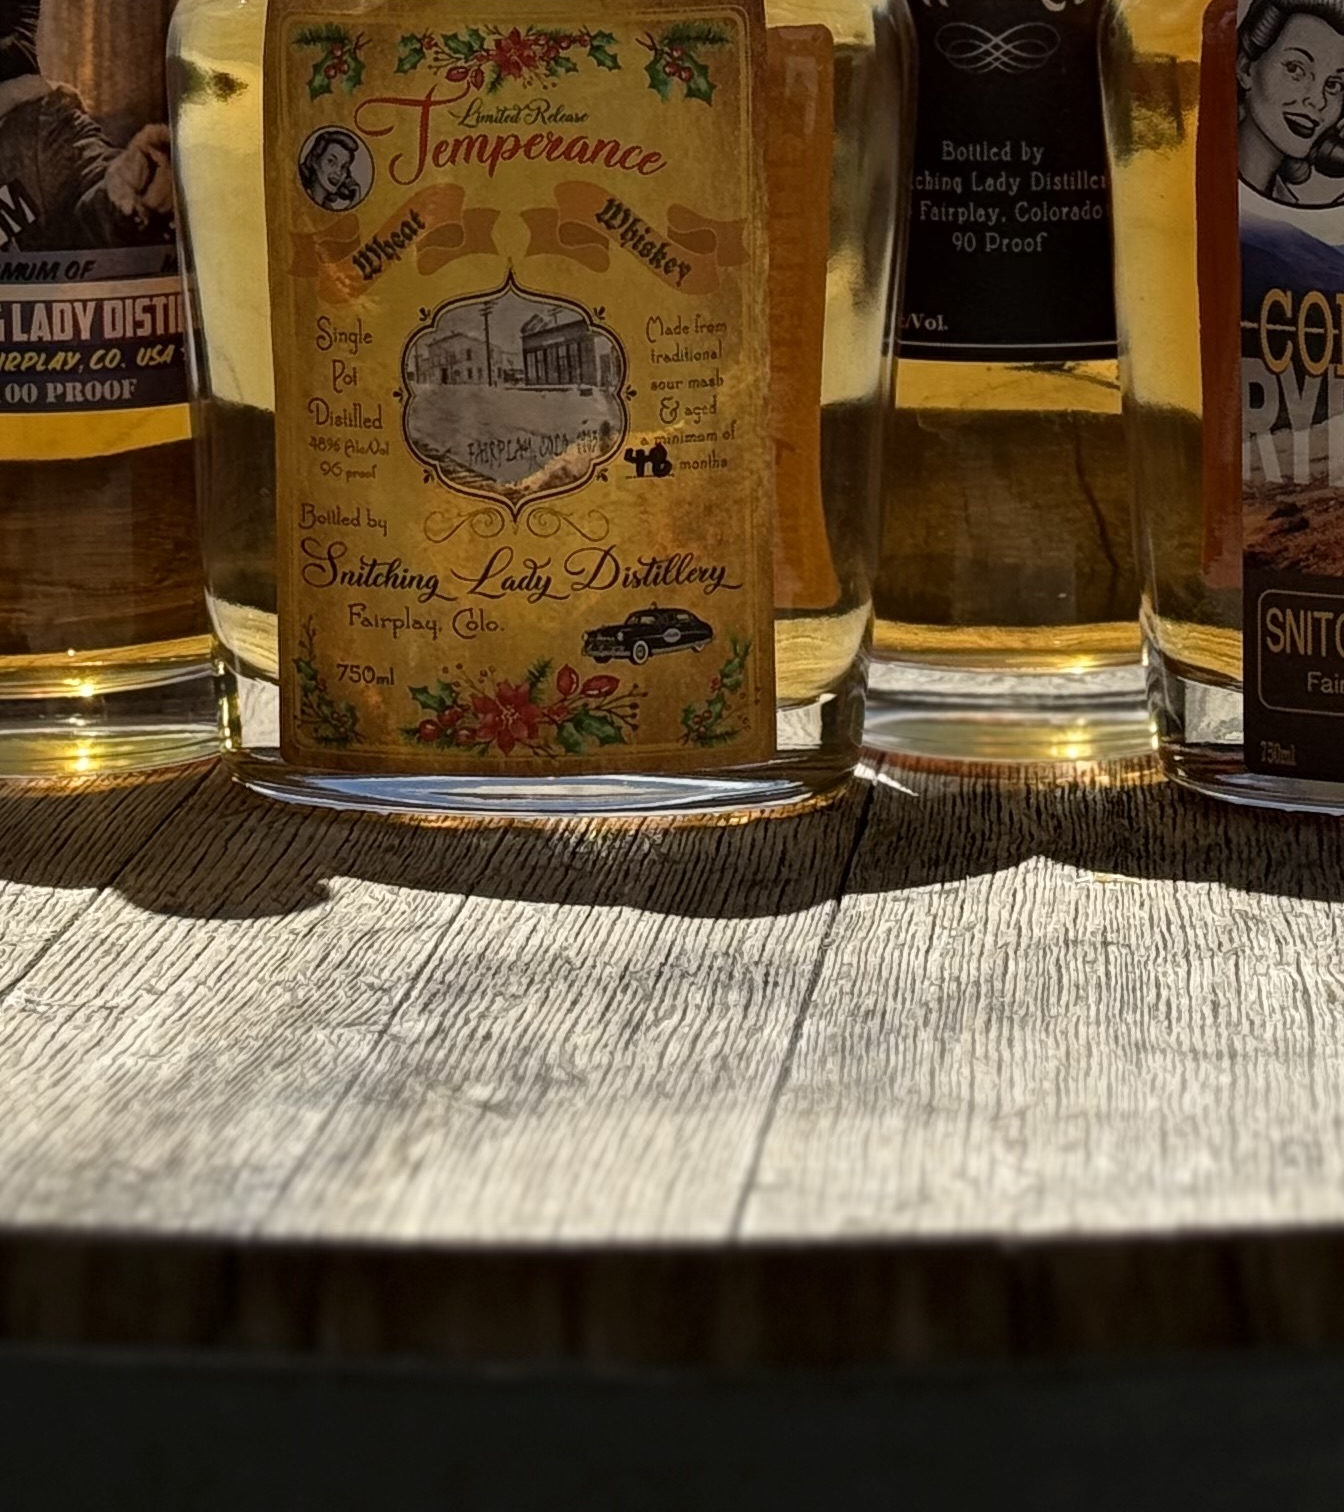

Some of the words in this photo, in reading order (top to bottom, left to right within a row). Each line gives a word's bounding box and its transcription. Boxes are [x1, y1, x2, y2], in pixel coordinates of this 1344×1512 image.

[447, 97, 523, 128] Limited
[523, 96, 590, 127] Release
[353, 78, 668, 186] Temperance
[941, 140, 1013, 162] Bottled
[1021, 140, 1046, 167] by
[971, 170, 1022, 196] Lady
[919, 200, 1007, 227] Fairplay,
[1015, 199, 1104, 223] Colorado
[351, 207, 427, 281] Wheat
[594, 197, 694, 287] Whiskey
[951, 231, 977, 253] 90
[984, 230, 1049, 253] Proof
[65, 259, 97, 278] OF
[11, 300, 97, 342] LADY
[315, 315, 373, 355] Single
[645, 315, 691, 344] Made
[694, 313, 729, 335] from
[89, 349, 127, 371] CO.
[136, 344, 176, 367] USA
[650, 338, 723, 365] traditional
[44, 377, 137, 403] PROOF
[331, 359, 358, 394] Pot
[650, 377, 684, 392] sour
[307, 397, 384, 430] Distilled
[659, 396, 680, 425] &
[684, 394, 718, 424] aged
[721, 419, 738, 440] of
[678, 449, 729, 471] months
[298, 502, 362, 531] Bottled
[365, 509, 389, 537] by
[300, 536, 458, 604] Snitching
[449, 544, 571, 600] Lady
[563, 543, 744, 596] Distillery
[347, 602, 444, 641] Fairplay,
[451, 607, 505, 640] Colo.
[335, 661, 395, 687] 750ml
